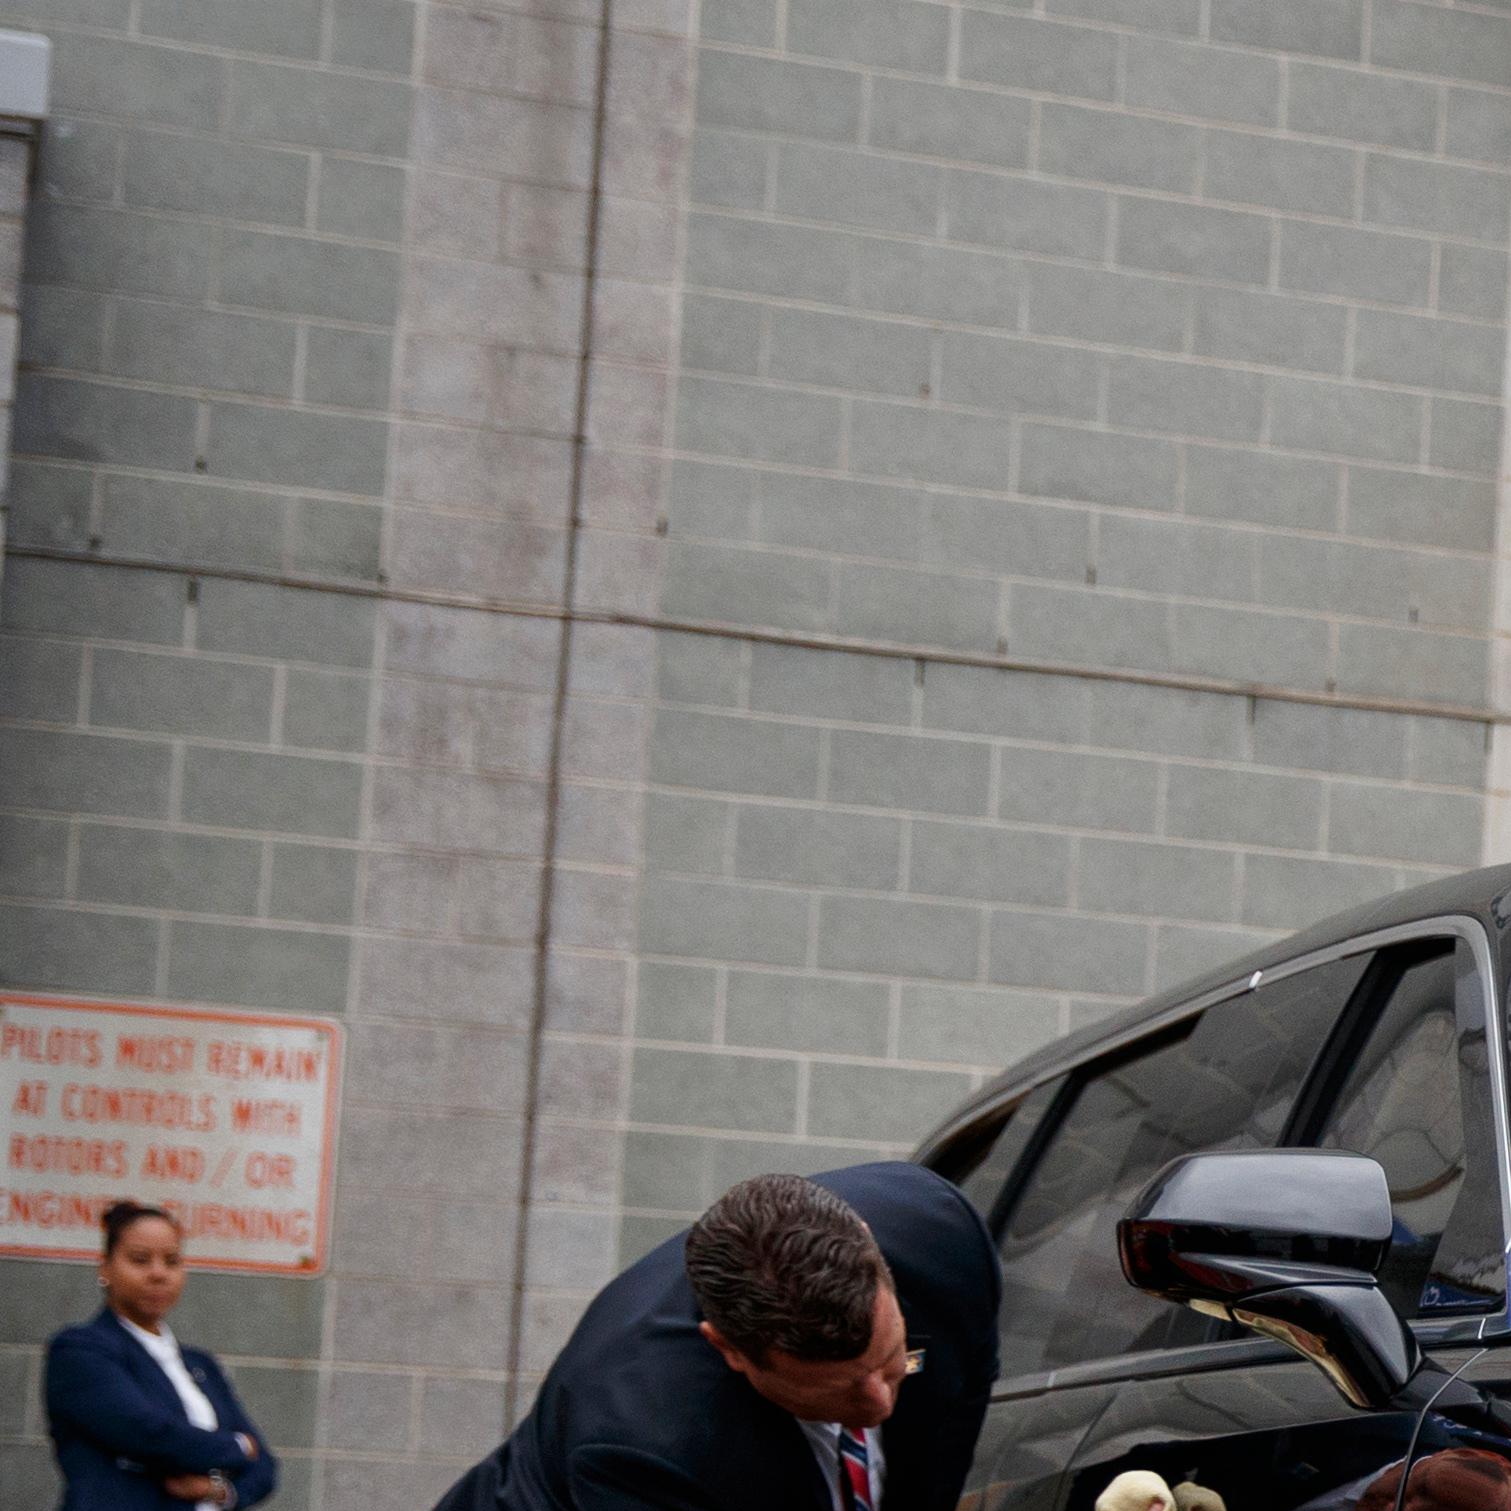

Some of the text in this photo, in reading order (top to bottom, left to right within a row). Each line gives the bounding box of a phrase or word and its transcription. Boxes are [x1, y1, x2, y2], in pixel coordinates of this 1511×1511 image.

[0, 1023, 320, 1081] PILOTS MUST REMAIN
[13, 1080, 301, 1136] AT CONTROLS WITH
[10, 1132, 127, 1178] ROTORS
[142, 1147, 203, 1183] AND
[245, 1151, 295, 1188] OR
